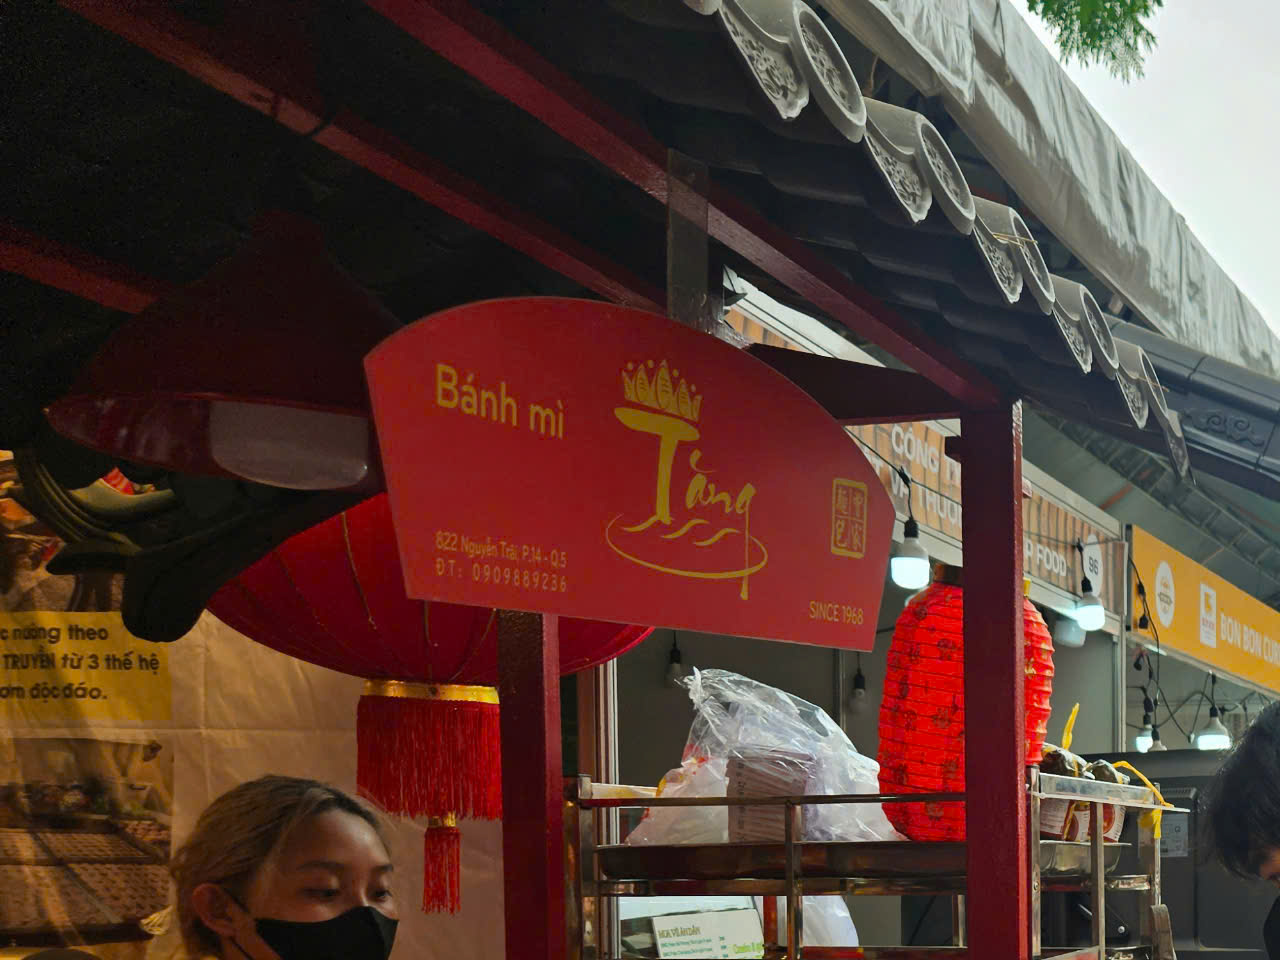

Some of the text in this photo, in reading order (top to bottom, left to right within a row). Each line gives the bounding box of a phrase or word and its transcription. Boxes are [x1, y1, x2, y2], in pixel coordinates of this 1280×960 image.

[435, 363, 566, 439] Bánh mì
[891, 425, 940, 473] CÔNG
[435, 530, 458, 551] 822
[1037, 544, 1067, 577] FOOD
[1088, 556, 1099, 576] 96
[472, 563, 567, 592] 0909889236
[808, 600, 864, 625] SINCE 1968
[67, 624, 109, 641] theo
[1243, 623, 1263, 658] BON
[2, 645, 161, 676] TRUYỀN từ 3 thế hệ
